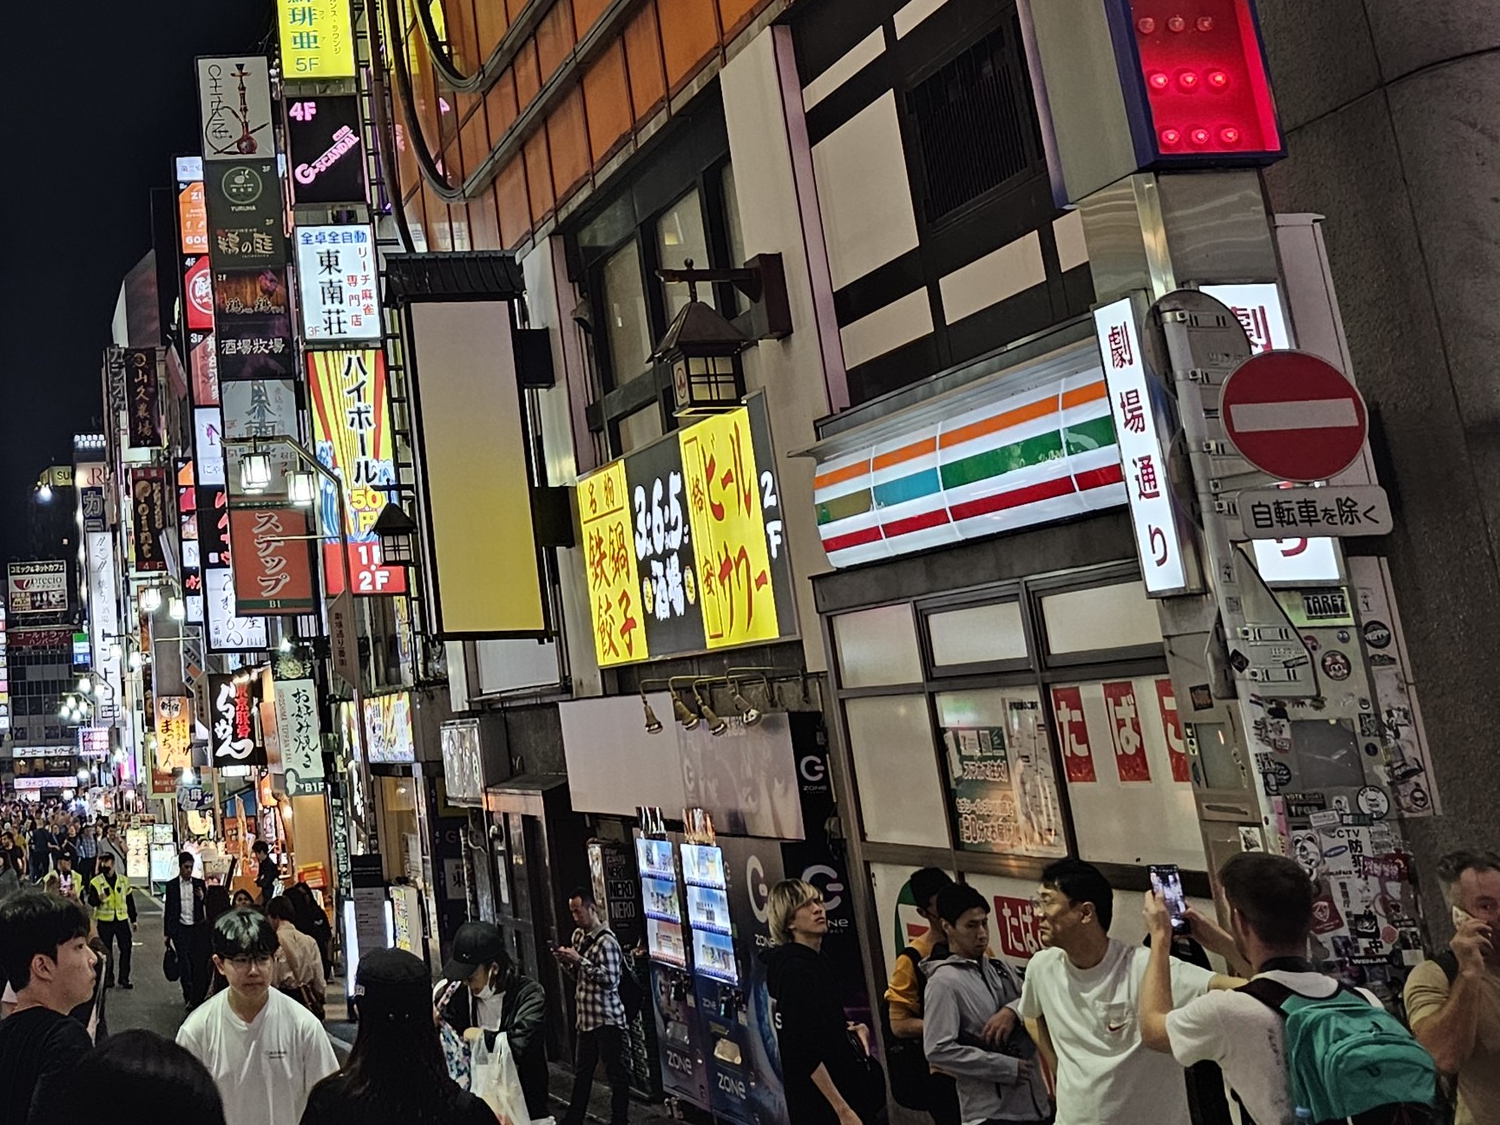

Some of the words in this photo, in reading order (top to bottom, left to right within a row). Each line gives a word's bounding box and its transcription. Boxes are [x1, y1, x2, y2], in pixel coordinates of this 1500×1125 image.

[295, 58, 320, 73] 5F
[289, 101, 317, 121] 4F
[295, 133, 360, 185] G-SCANDAL
[300, 230, 368, 245] 全卓全自動
[316, 249, 348, 336] 東南荘
[347, 274, 363, 327] 専門店
[358, 247, 375, 316] リーチ麻雀
[220, 338, 285, 355] 酒場牧場
[308, 326, 320, 336] 3F
[344, 356, 378, 483] ハイボール
[1108, 321, 1169, 567] 劇場通り
[587, 473, 615, 515] 名物
[701, 420, 753, 521] ビール
[693, 477, 716, 597] 格安
[760, 471, 783, 560] 2F
[1251, 497, 1380, 528] 自転車を除く
[252, 511, 291, 598] ステップ
[358, 571, 390, 591] 2F
[588, 520, 631, 593] 鉄鍋
[717, 540, 769, 638] サワー
[291, 687, 318, 769] お好み焼き
[304, 782, 325, 793] B1F
[1001, 901, 1046, 958] たば
